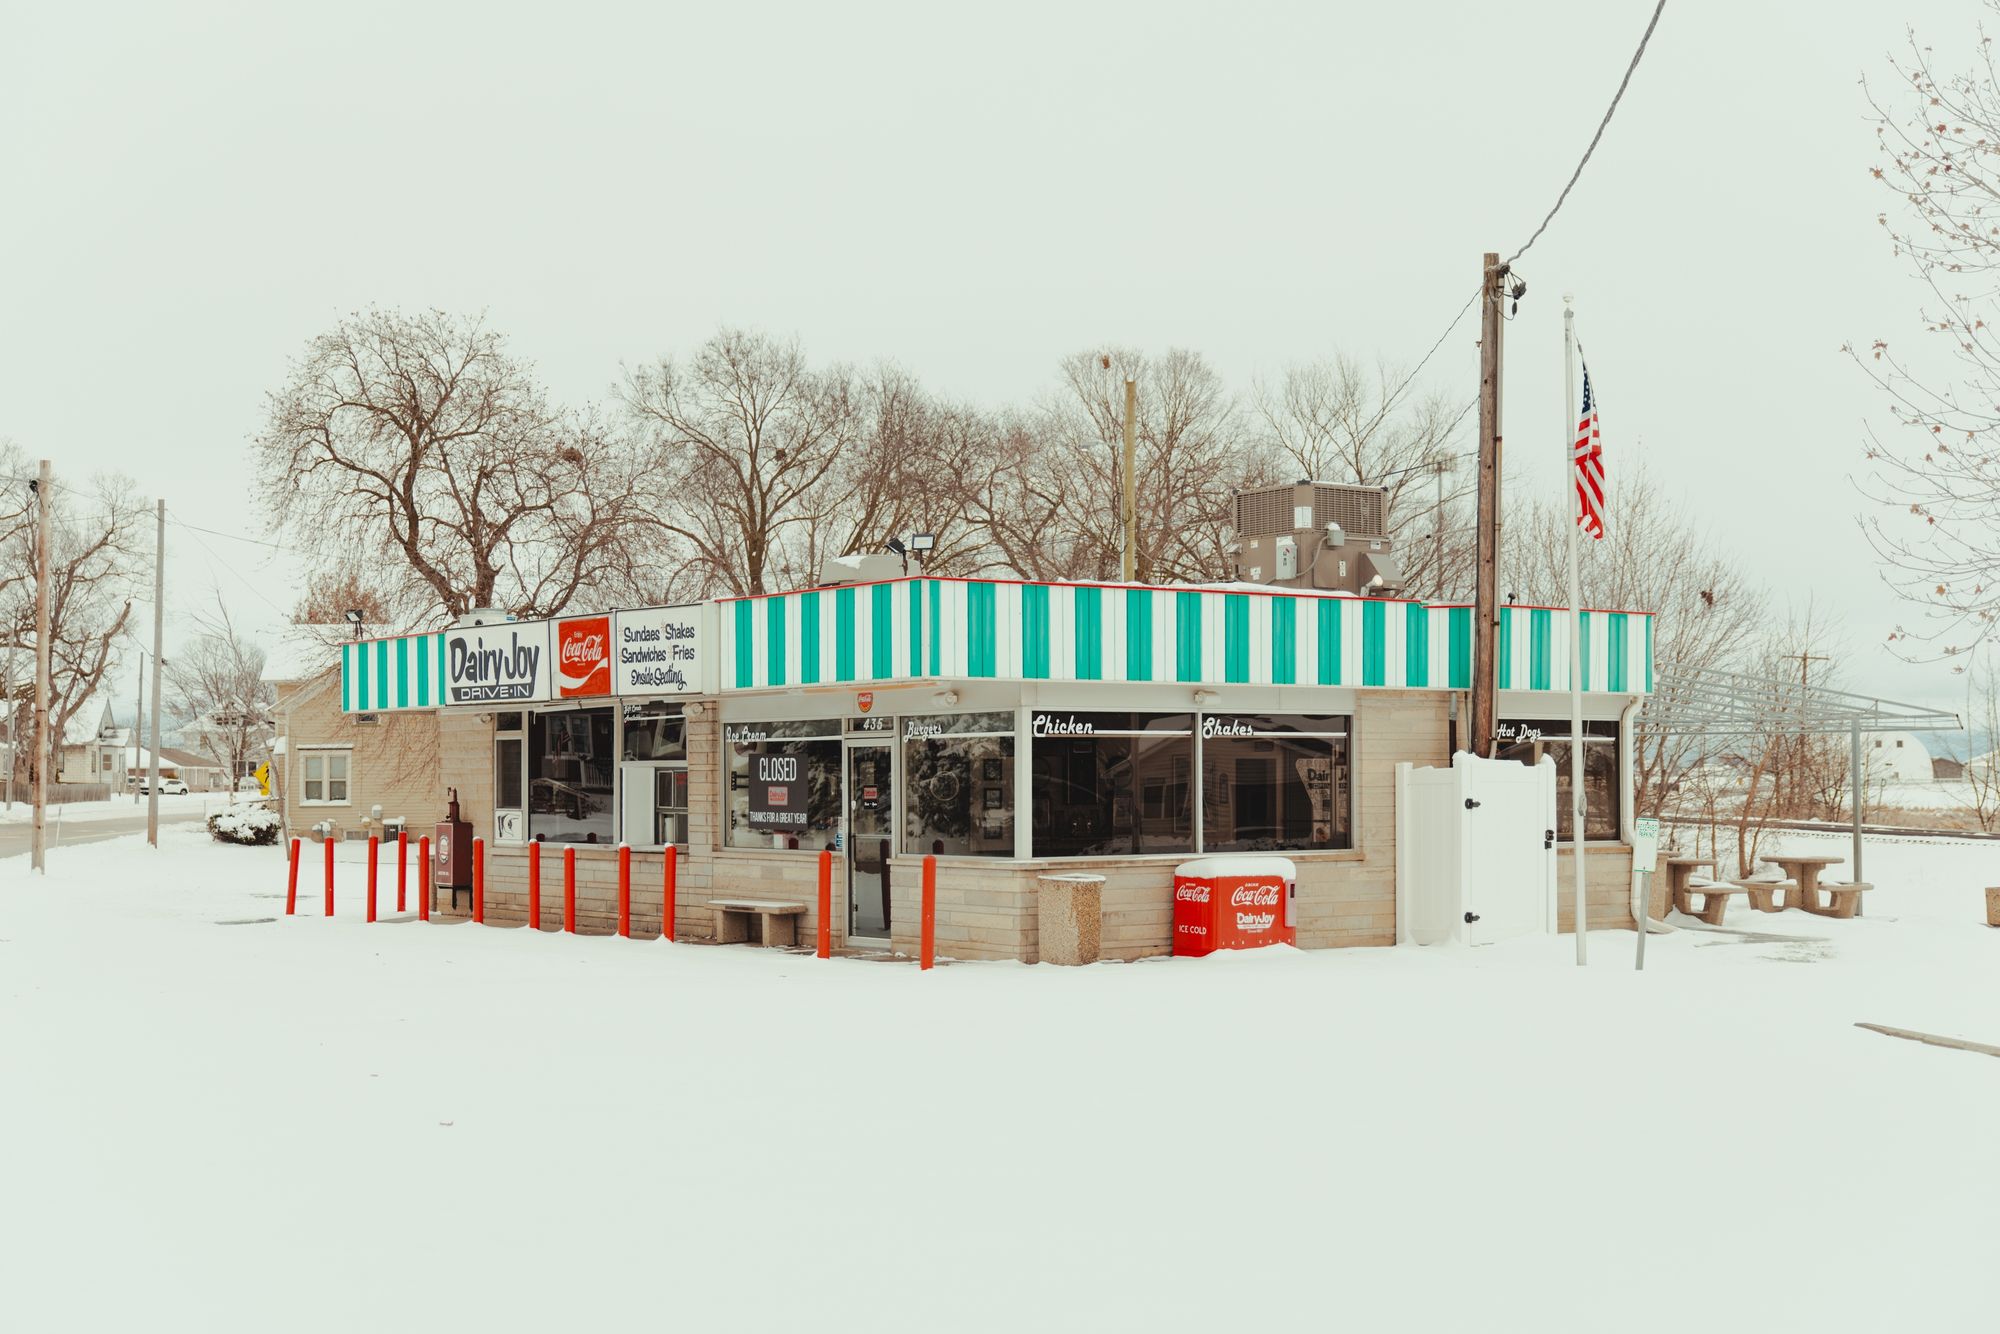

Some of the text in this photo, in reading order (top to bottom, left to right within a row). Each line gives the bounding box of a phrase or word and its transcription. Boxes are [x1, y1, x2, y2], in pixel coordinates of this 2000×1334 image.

[623, 623, 695, 643] Sundaes Shakes
[562, 634, 604, 663] Coca-Cola
[621, 644, 695, 664] Sandwiches Fries
[449, 632, 540, 686] Dairy Joy
[631, 664, 687, 691] Inside Seating
[863, 718, 883, 730] 435
[903, 722, 943, 742] Burgers
[1032, 714, 1094, 738] Chicken
[1202, 716, 1254, 739] Shakes
[1497, 724, 1542, 743] Hot Dogs
[726, 726, 768, 745] Ice Cream
[759, 757, 797, 781] CLOSED
[750, 811, 767, 822] THANKS
[767, 812, 775, 822] FOR
[780, 812, 793, 823] GREAT
[794, 813, 807, 824] YEAR!
[1176, 885, 1211, 903] Coca-Cola
[1231, 885, 1280, 906] Coca-Cola
[1236, 911, 1275, 926] Dairy Joy
[1179, 925, 1207, 935] ICE COLD
